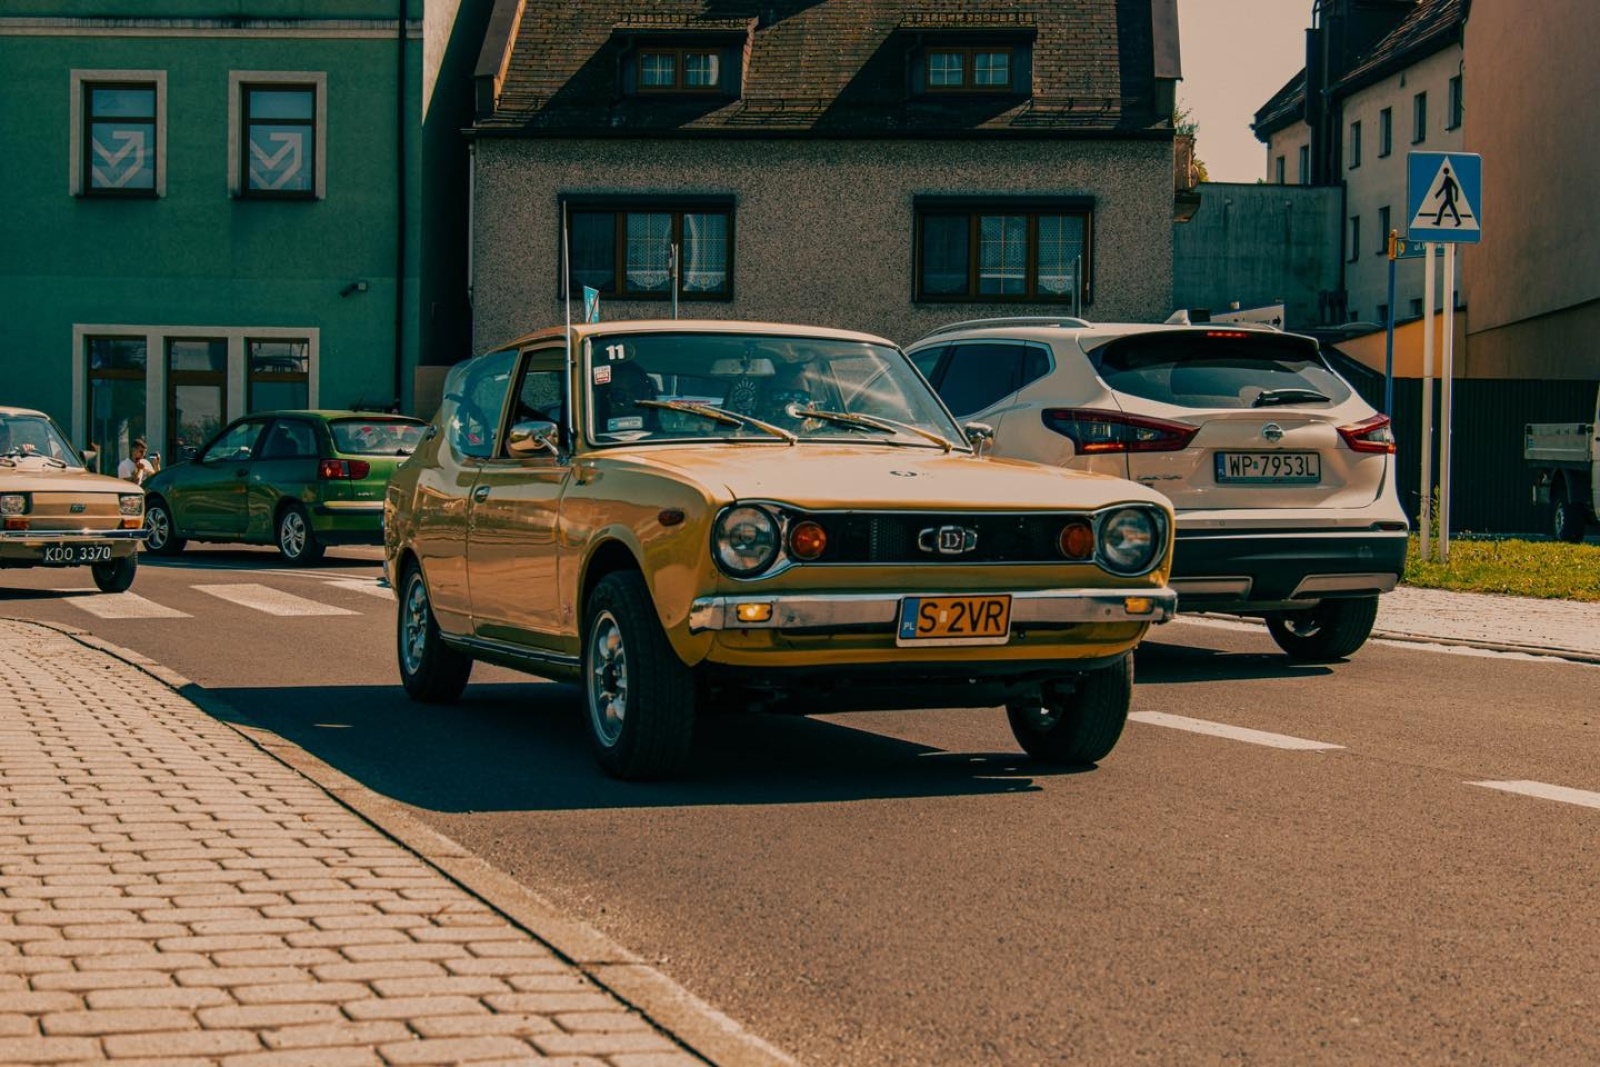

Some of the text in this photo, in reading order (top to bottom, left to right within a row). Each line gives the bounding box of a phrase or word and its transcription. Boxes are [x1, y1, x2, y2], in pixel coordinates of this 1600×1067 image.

[605, 344, 625, 360] 11
[1229, 456, 1316, 476] WP 7953L
[45, 546, 111, 561] KDO 3370
[903, 622, 915, 631] PL
